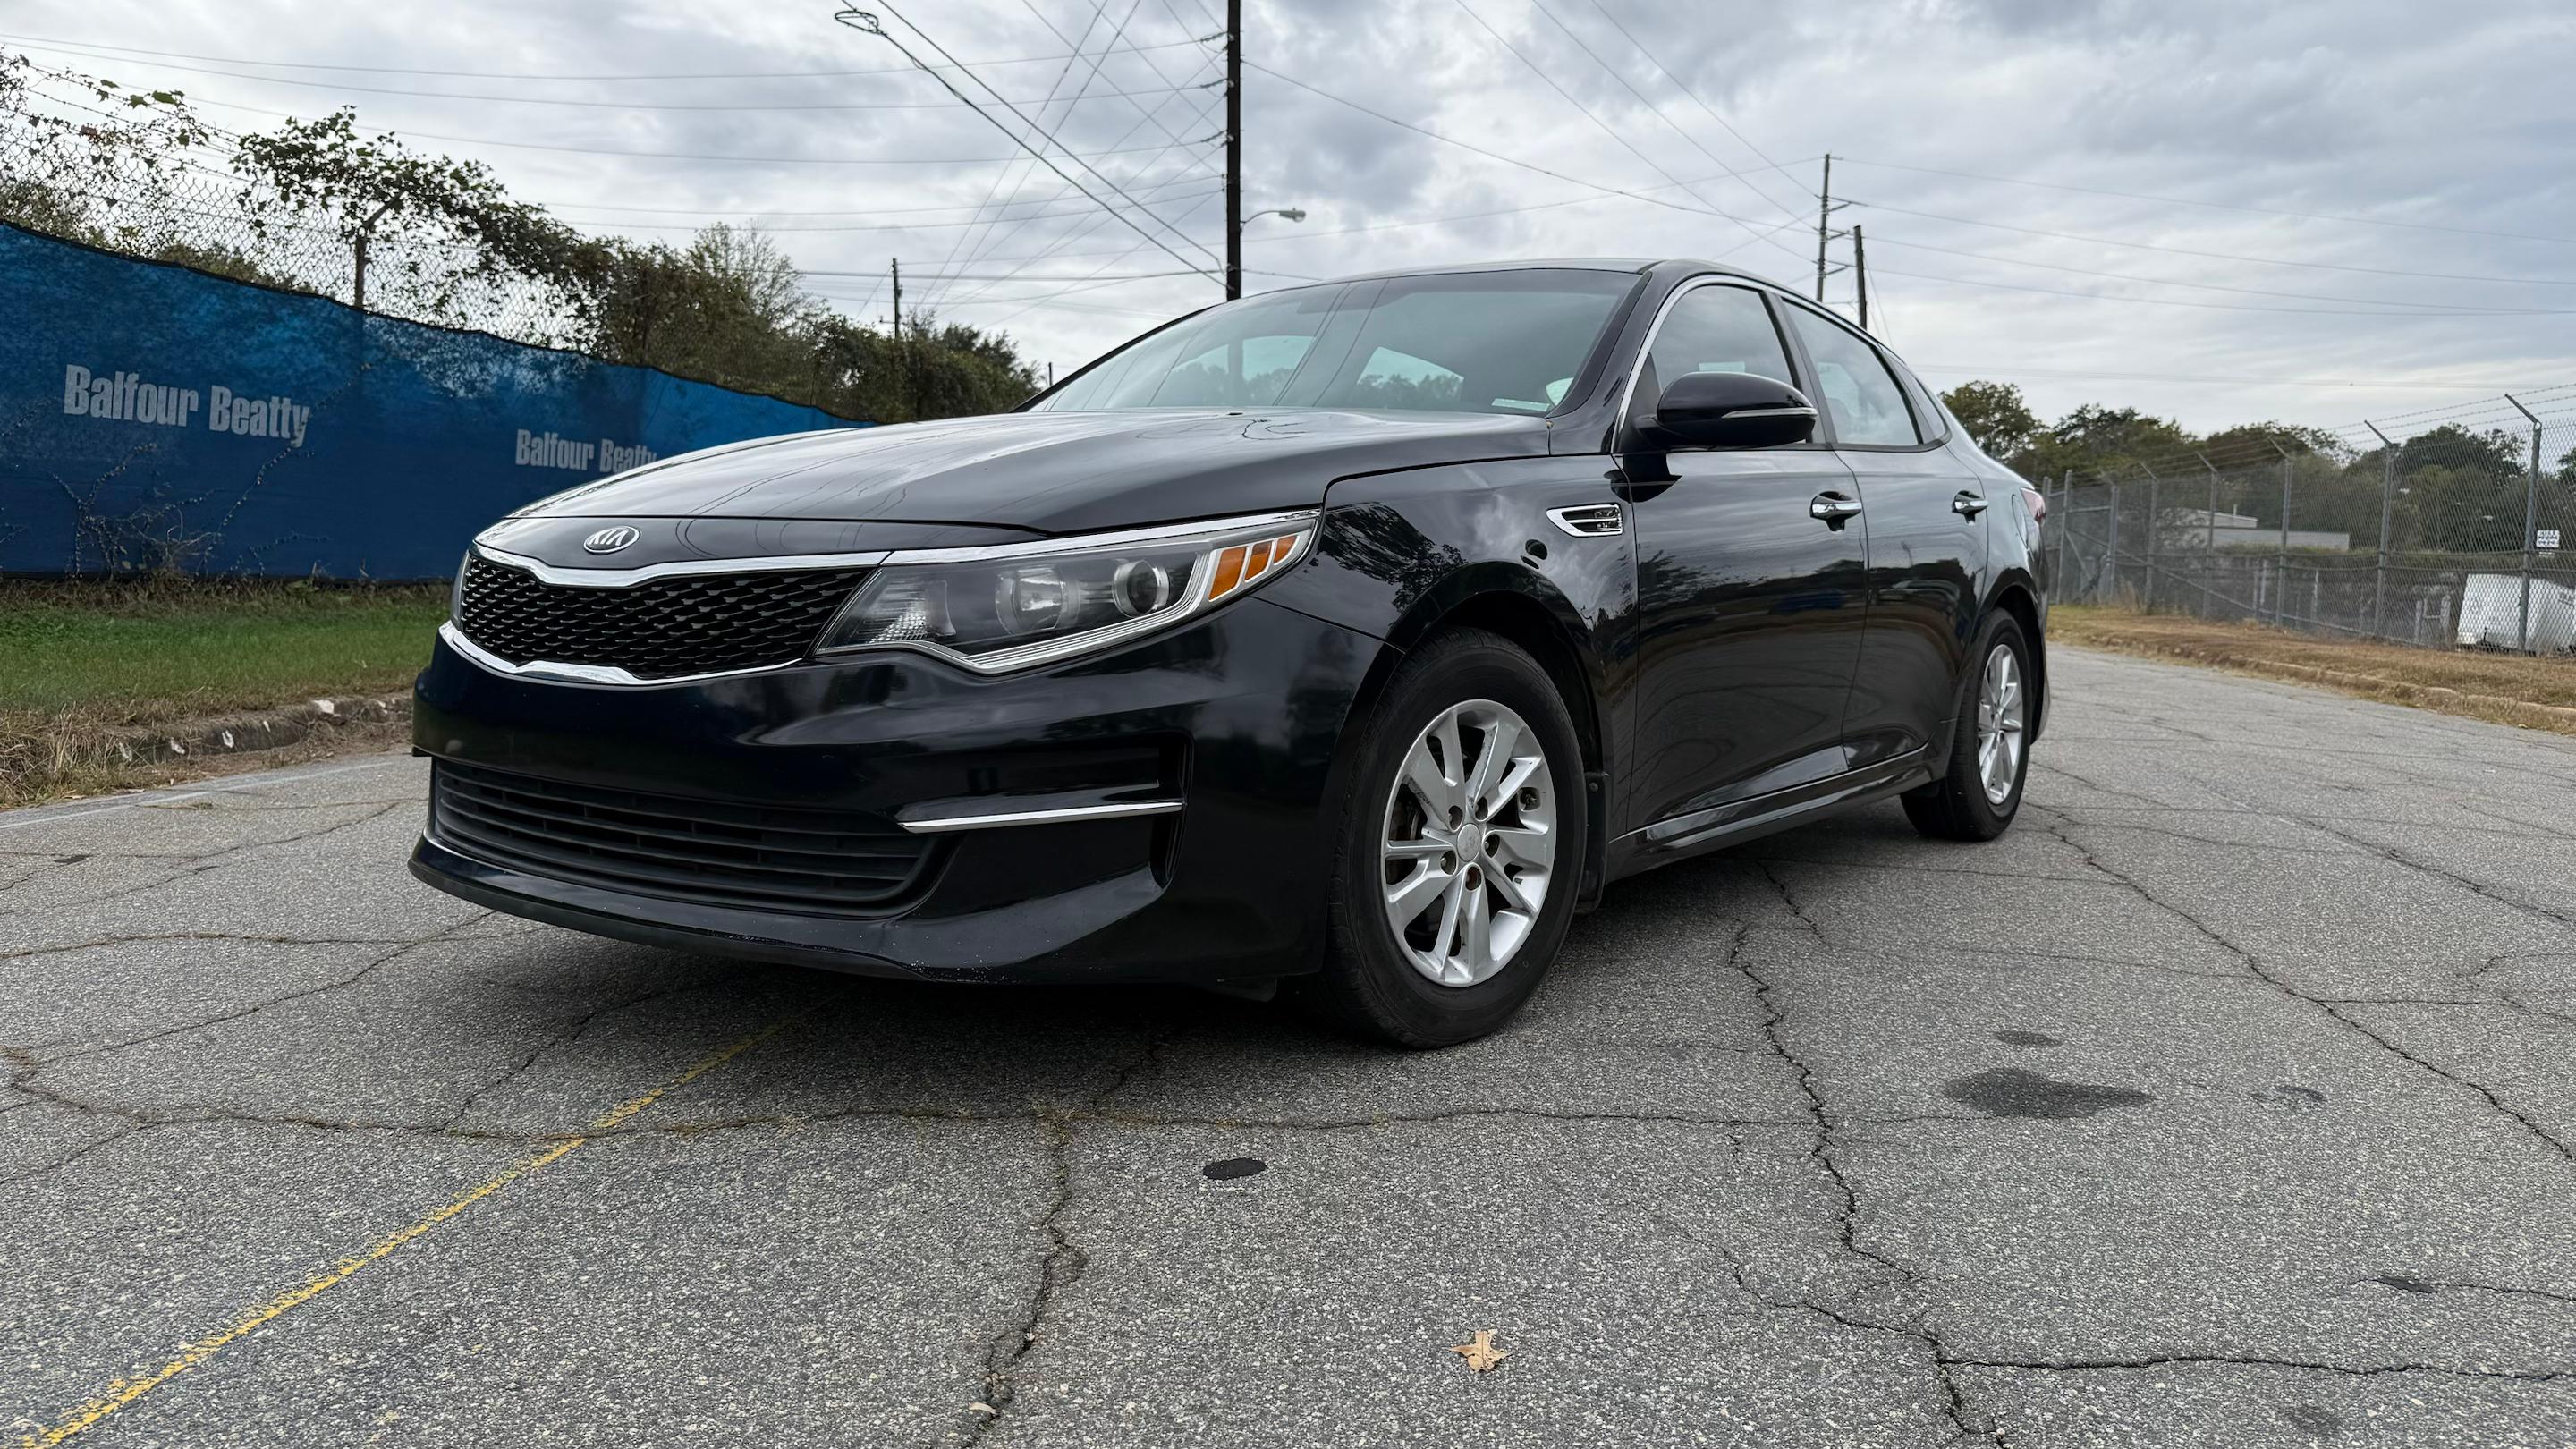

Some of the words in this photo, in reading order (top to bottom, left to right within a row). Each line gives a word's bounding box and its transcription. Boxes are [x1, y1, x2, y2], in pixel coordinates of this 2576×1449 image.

[64, 364, 199, 428] Balfour
[208, 385, 310, 448] Beatty
[515, 428, 595, 470] Balfour
[586, 528, 630, 547] KIA
